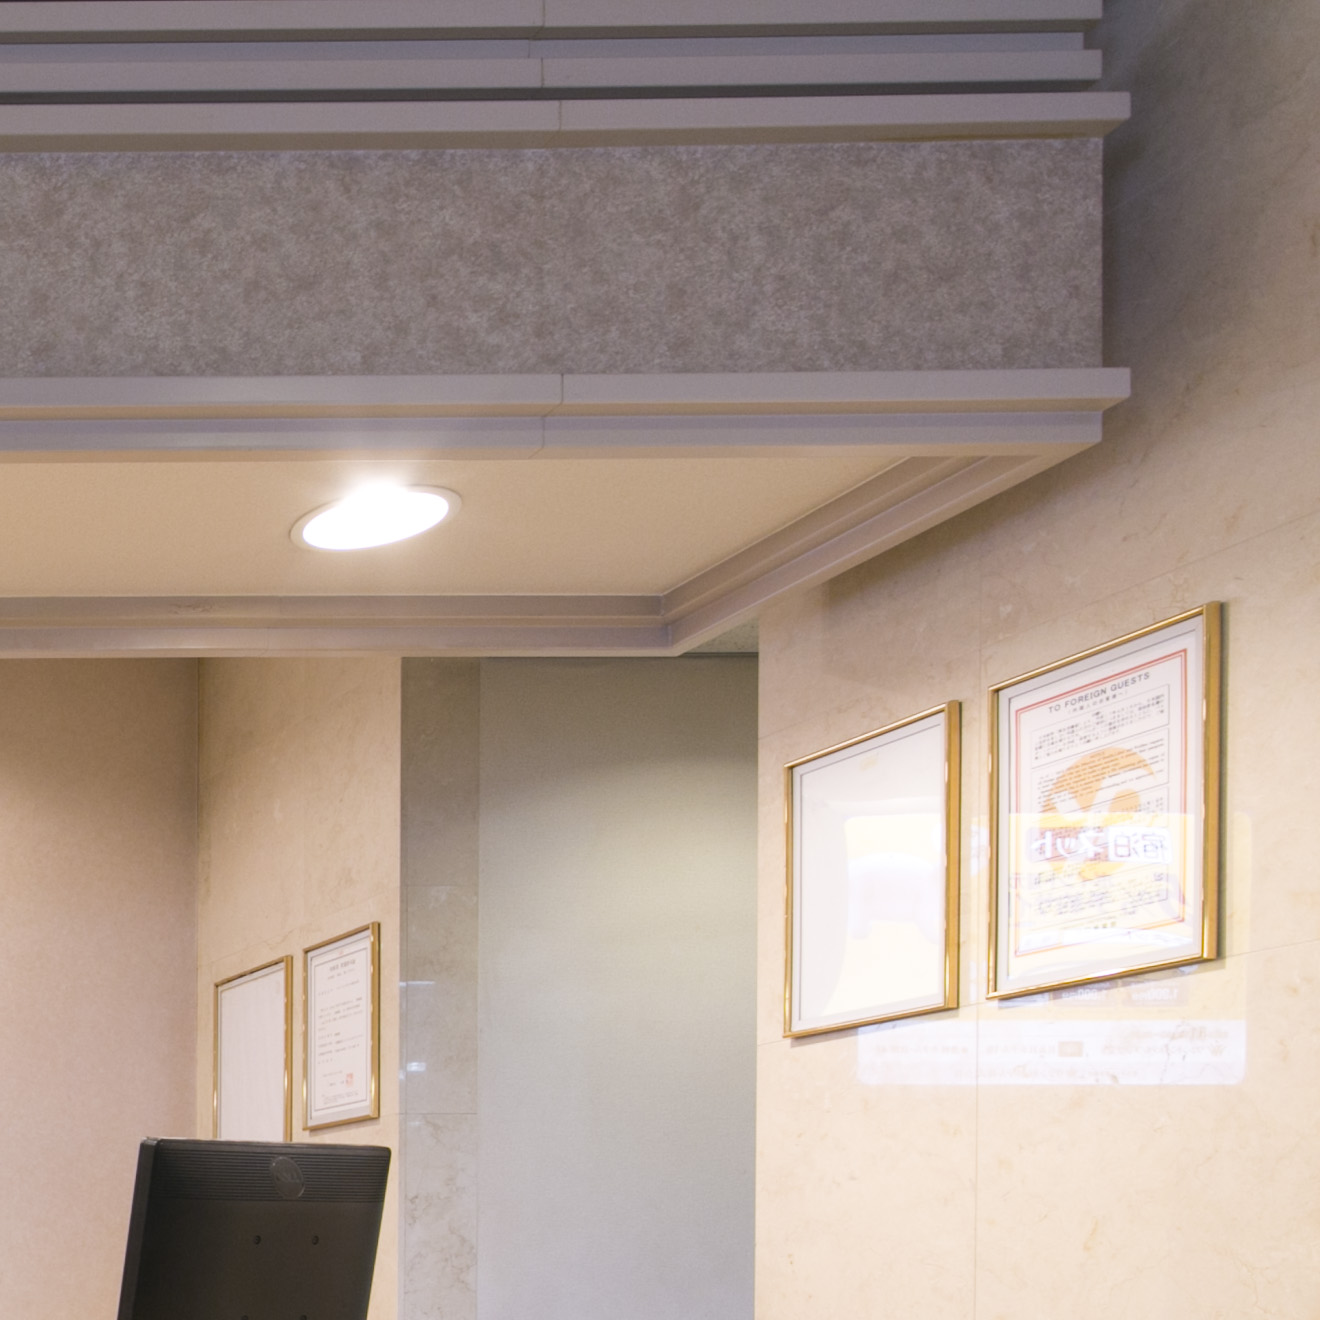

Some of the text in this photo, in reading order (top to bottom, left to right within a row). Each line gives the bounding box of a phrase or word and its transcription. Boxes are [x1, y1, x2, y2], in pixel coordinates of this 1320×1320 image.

[1048, 704, 1060, 713] TO
[1064, 688, 1106, 708] FOREIGN
[1110, 672, 1150, 692] GUESTS
